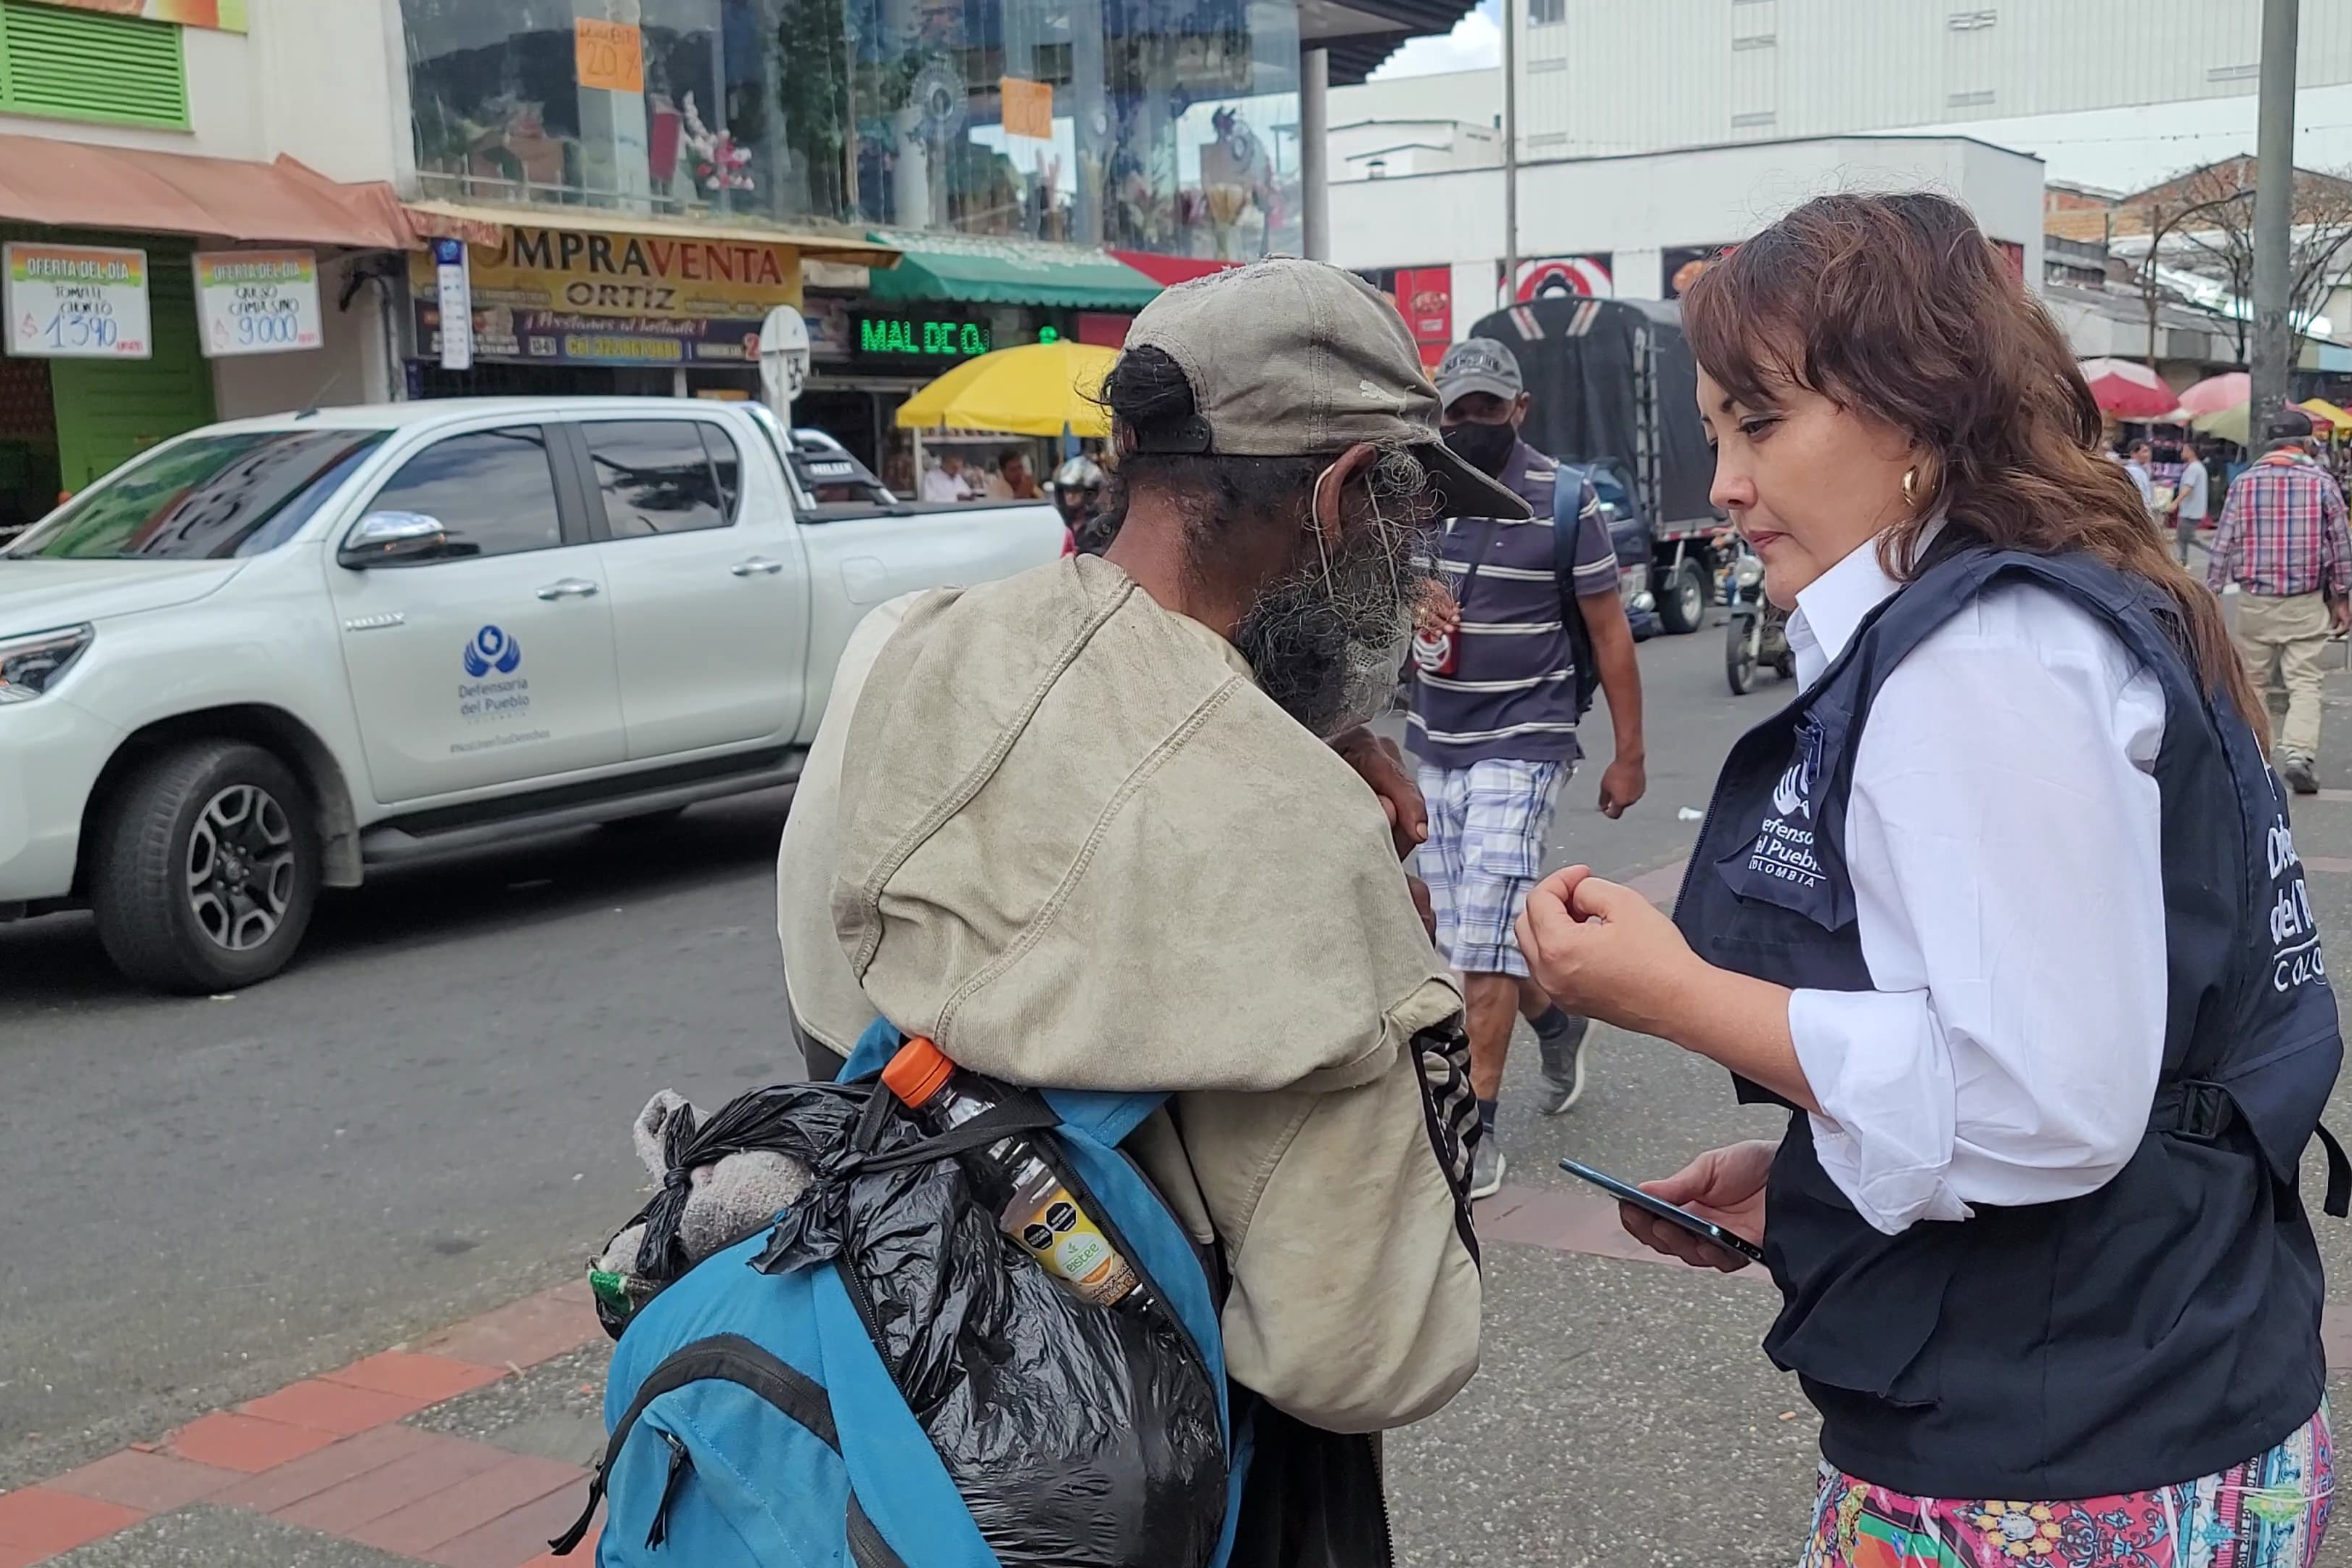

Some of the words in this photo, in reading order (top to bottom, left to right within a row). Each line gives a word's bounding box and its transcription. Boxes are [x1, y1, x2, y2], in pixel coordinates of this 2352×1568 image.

[27, 258, 76, 277] OFERTA
[81, 261, 104, 279] DEL
[861, 319, 920, 354] MAL
[460, 699, 481, 716] del
[485, 694, 530, 712] Pueblo
[2274, 947, 2325, 992] COLO
